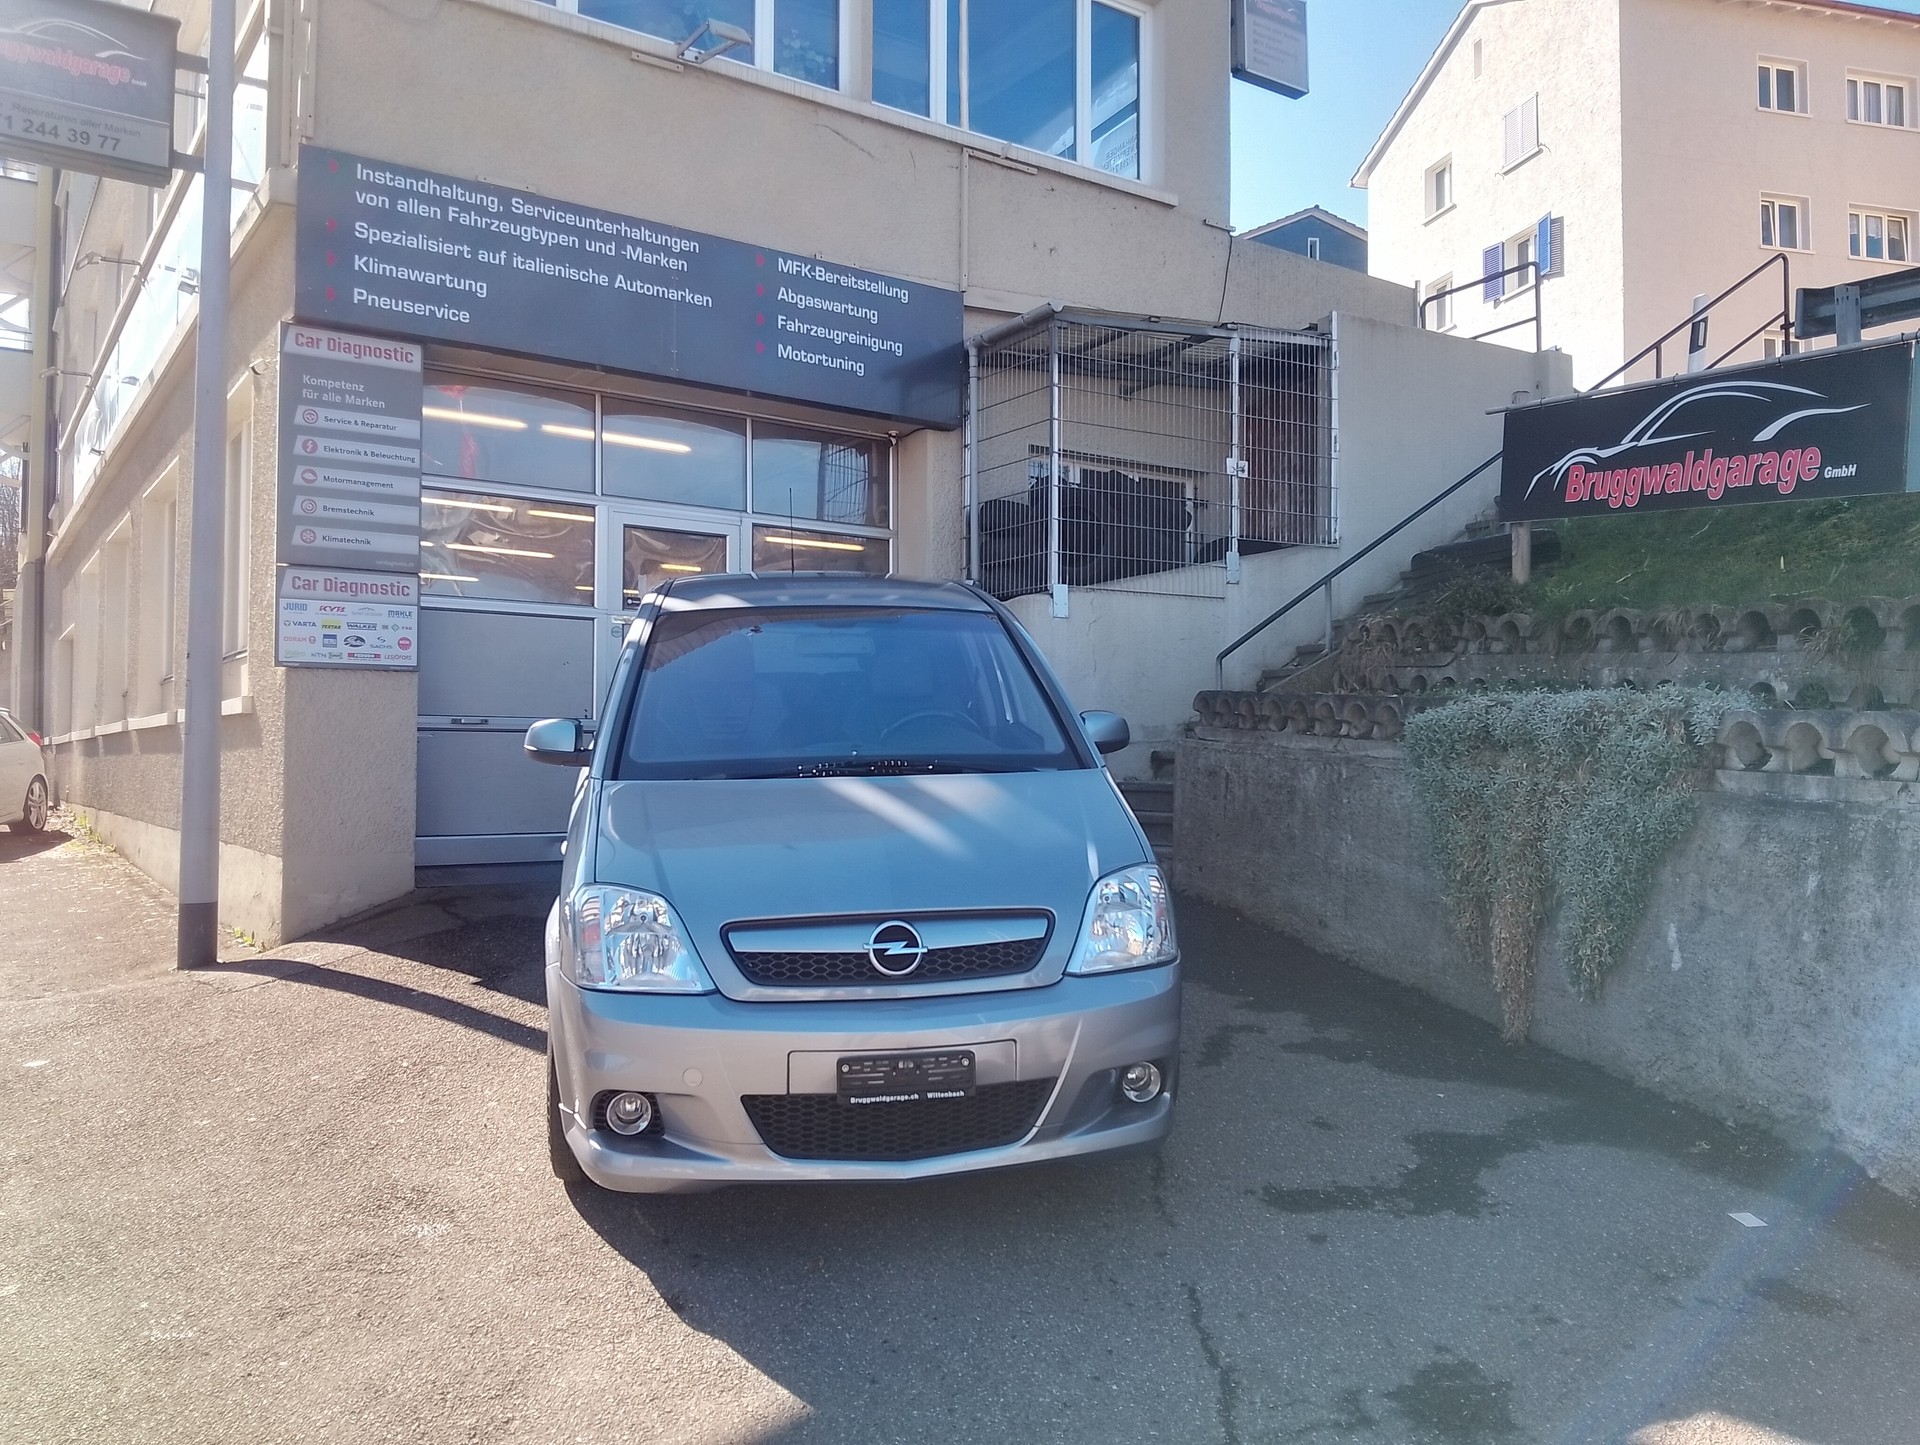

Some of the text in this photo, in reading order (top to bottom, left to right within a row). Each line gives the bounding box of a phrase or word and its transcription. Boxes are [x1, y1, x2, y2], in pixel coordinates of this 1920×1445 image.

[22, 118, 60, 140] 244
[67, 128, 91, 146] 39
[97, 134, 121, 152] 77
[104, 123, 142, 138] Marken
[356, 163, 700, 254] Instandhaltung, Serviceunterhaltungen
[355, 190, 689, 273] von allen Fahrzeugtypen und -Marken
[354, 222, 713, 308] Spezialisiert auf italienische Automarken
[354, 255, 488, 299] Klimawartung
[777, 257, 910, 304] MFK-Bereitstellung
[353, 288, 471, 324] Pneuservice
[777, 286, 878, 324] Abgaswartung
[777, 314, 903, 356] Fahrzeugreinigung
[294, 331, 415, 364] Car Diagnostic
[777, 343, 865, 377] Motortuning
[302, 374, 365, 393] Kompetenz
[302, 388, 386, 409] für alle Marken
[323, 415, 398, 432] Service & Reparatur
[323, 445, 362, 457] Elektronik
[370, 450, 416, 464] Beleuchtung
[323, 475, 394, 490] Motormanagement
[1564, 446, 1857, 508] Bruggwaldgarage GmbH
[322, 505, 375, 517] Bremstechnik
[322, 535, 372, 546] Klimatechnik
[291, 575, 411, 597] Car Diagnostic
[283, 602, 308, 612] JURID
[292, 620, 317, 628] VARTA
[347, 622, 378, 630] WALKER
[850, 1090, 965, 1104] Bruggwaldgarage.ch Wittenbach
